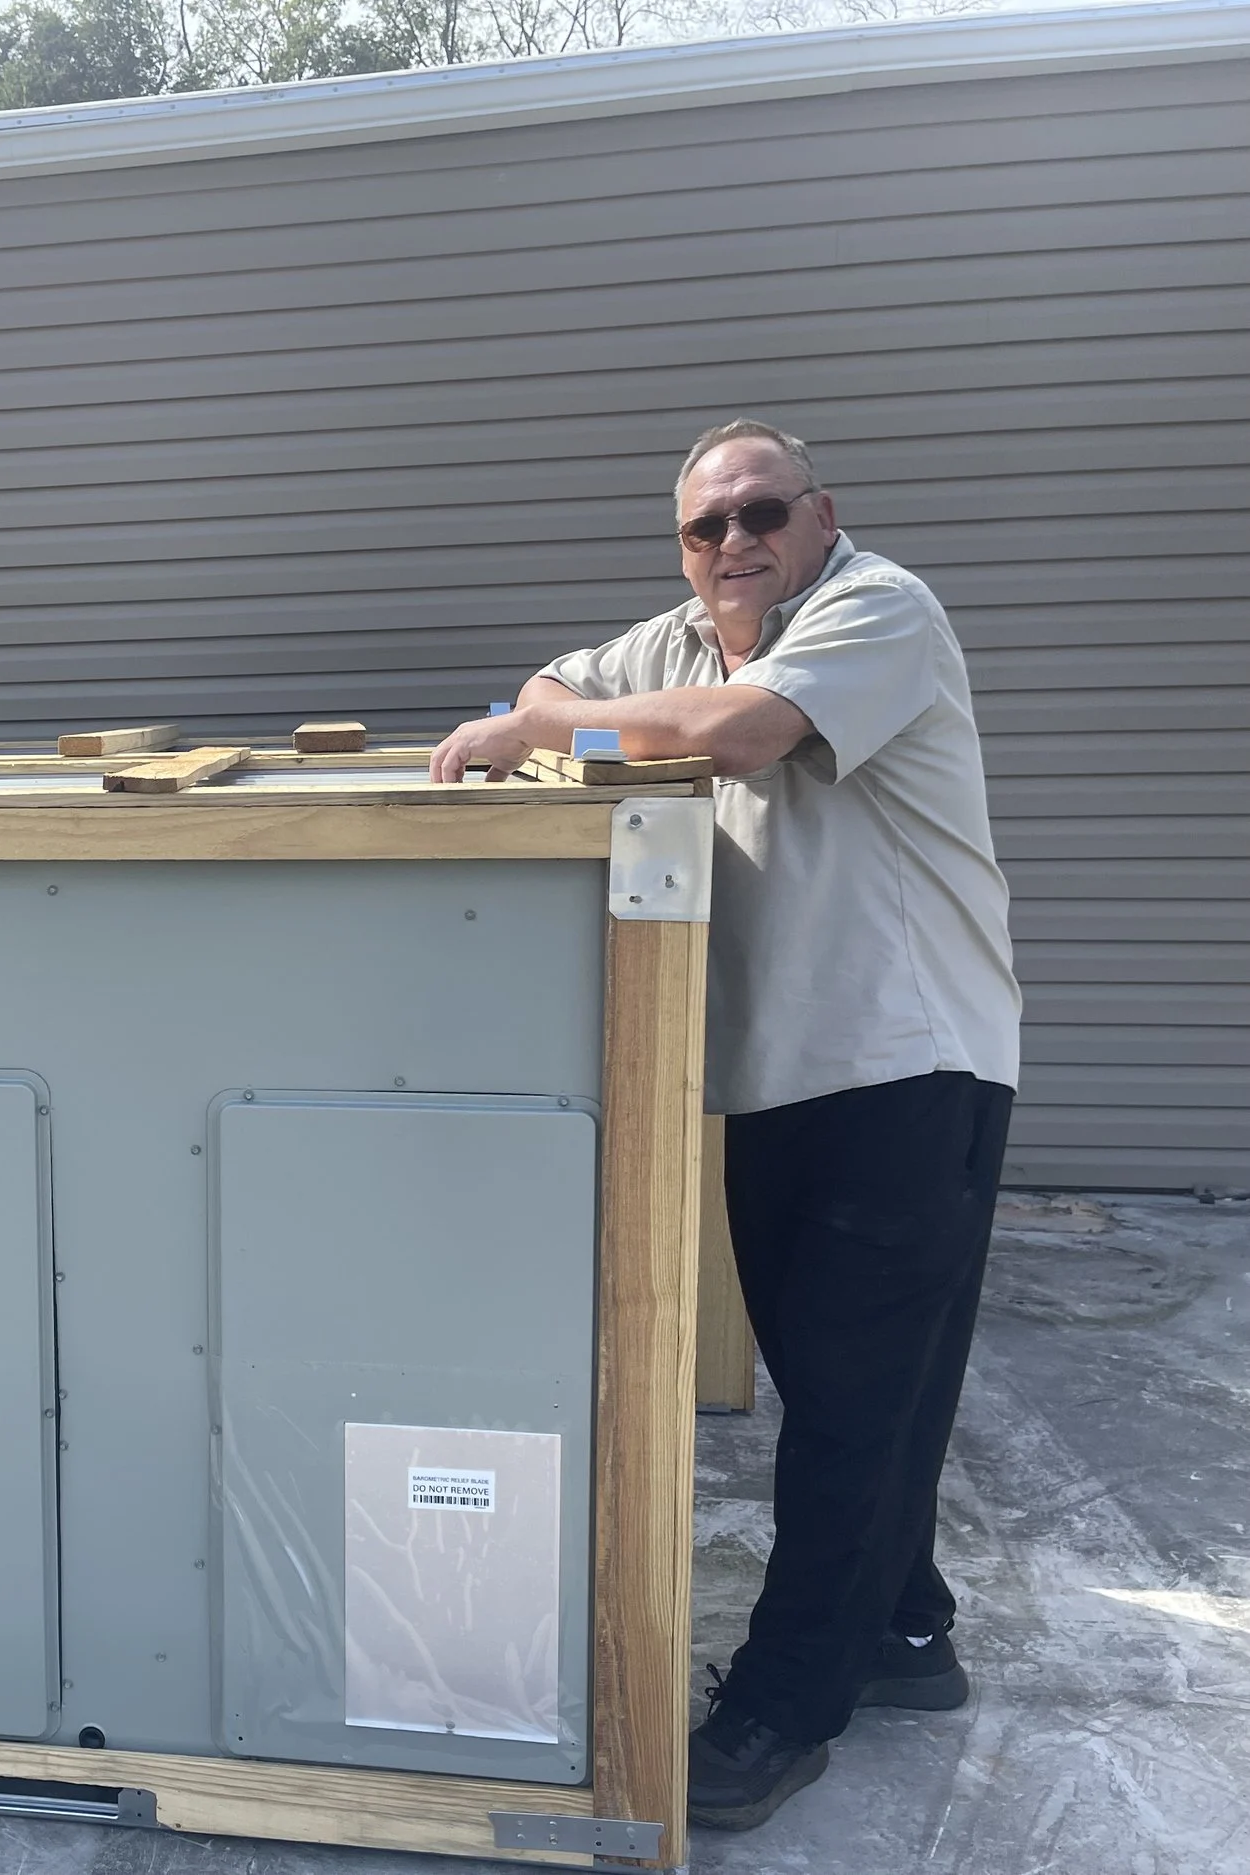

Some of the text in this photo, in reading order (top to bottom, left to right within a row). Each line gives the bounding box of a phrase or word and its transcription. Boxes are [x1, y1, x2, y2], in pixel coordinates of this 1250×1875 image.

[412, 1475, 449, 1483] BAROMETRIC
[412, 1484, 489, 1496] DO NOT REMOVE
